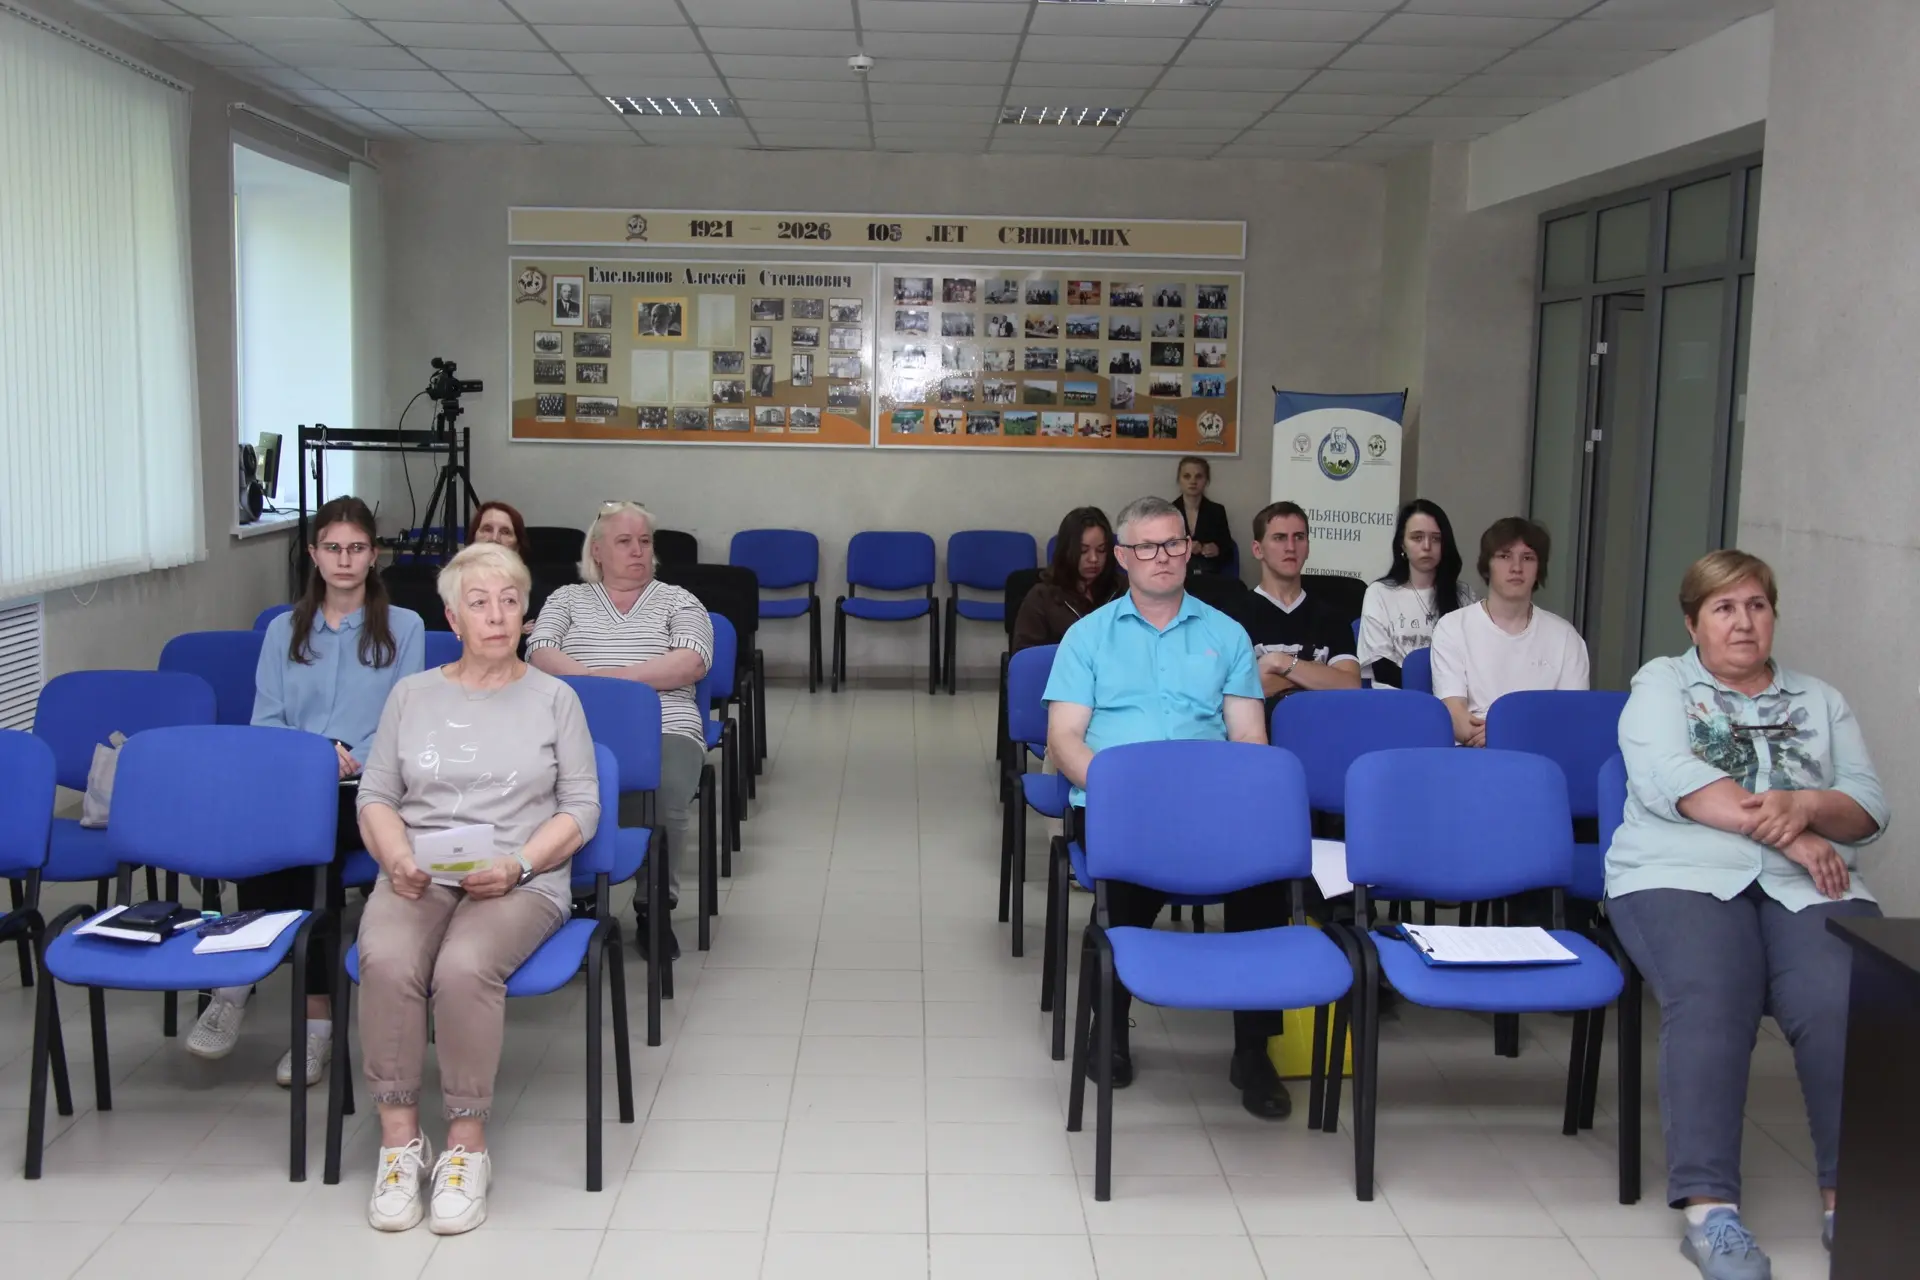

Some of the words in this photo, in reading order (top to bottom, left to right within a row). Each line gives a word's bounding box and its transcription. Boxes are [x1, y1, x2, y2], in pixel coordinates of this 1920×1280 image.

[688, 220, 734, 237] 1921
[778, 221, 831, 240] 2026
[867, 223, 902, 241] 105
[926, 224, 968, 242] ЛЕТ
[588, 266, 673, 284] Емельянов
[682, 268, 746, 285] Алексей
[759, 269, 851, 288] Степанович
[1303, 508, 1394, 526] ЛЬЯНОВСКИЕ
[1309, 526, 1361, 542] ЧТЕНИЯ
[1305, 567, 1320, 575] ПРИ
[1320, 568, 1362, 579] ПОДДЕРЖКЕ
